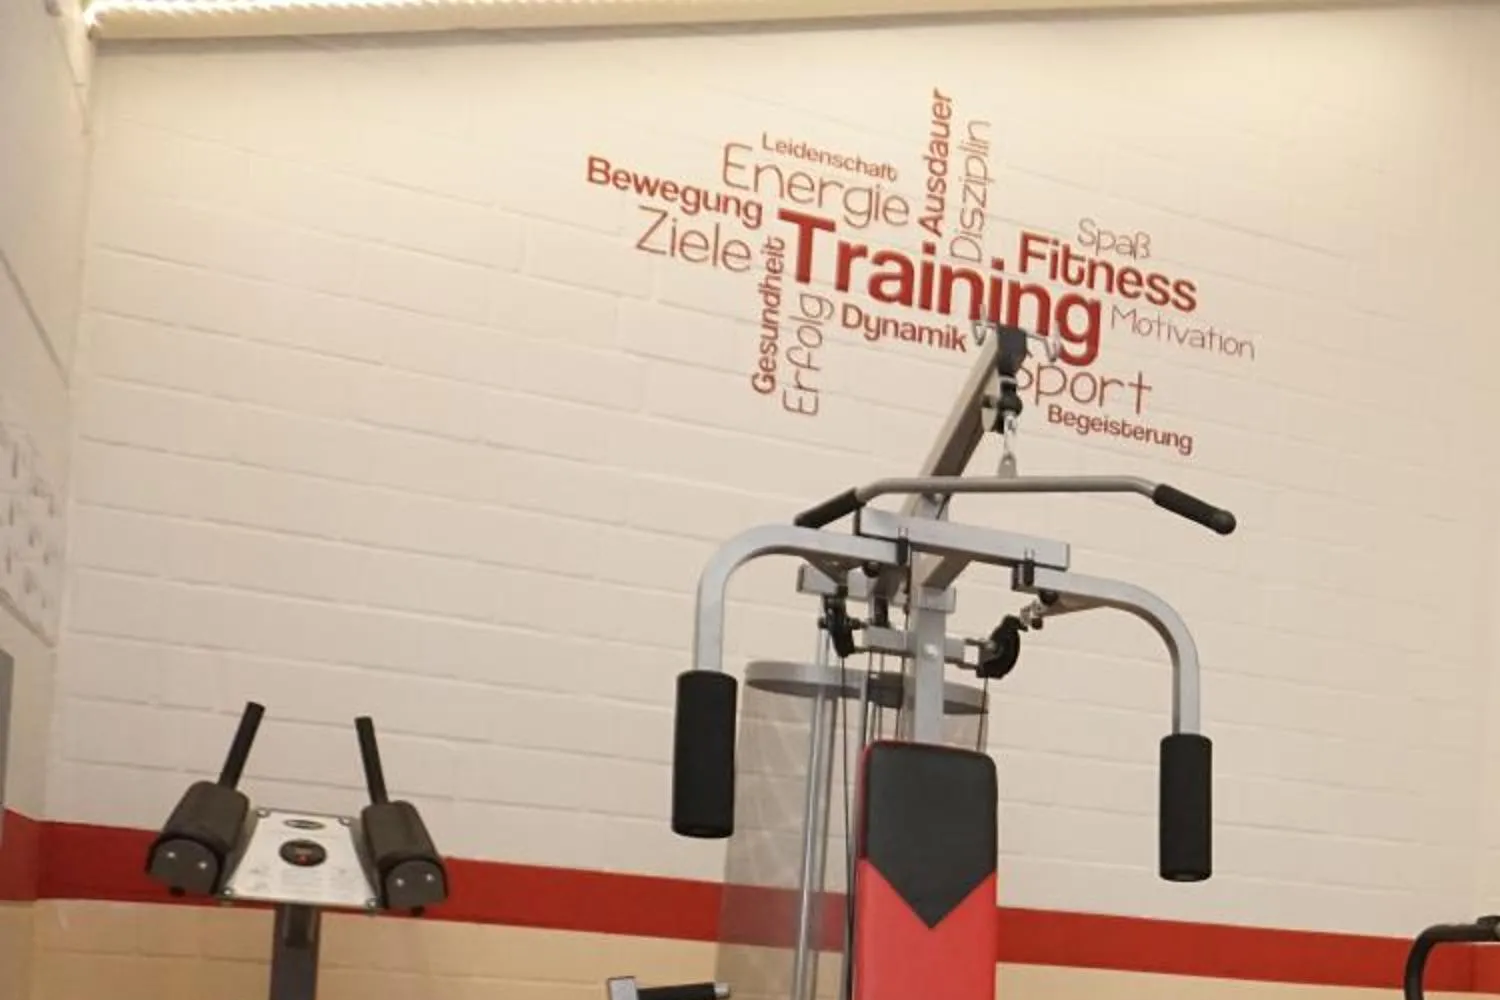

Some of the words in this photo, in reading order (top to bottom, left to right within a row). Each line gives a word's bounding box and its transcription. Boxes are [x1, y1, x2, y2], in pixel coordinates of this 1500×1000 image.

[586, 155, 763, 229] Bewegung
[722, 142, 910, 228] Energie
[761, 132, 897, 181] Leidenschaft
[917, 87, 953, 237] Ausdauer
[949, 120, 993, 264] Disziplin
[636, 204, 752, 272] Ziele
[1018, 231, 1197, 312] Fitness
[1077, 218, 1151, 259] Spaß
[752, 236, 785, 394] Gesundheit
[778, 208, 1102, 366] Training
[783, 294, 834, 416] Erfolg
[841, 302, 967, 352] Dynamik
[1110, 303, 1255, 360] Motivation
[1047, 403, 1194, 455] Begeisterung
